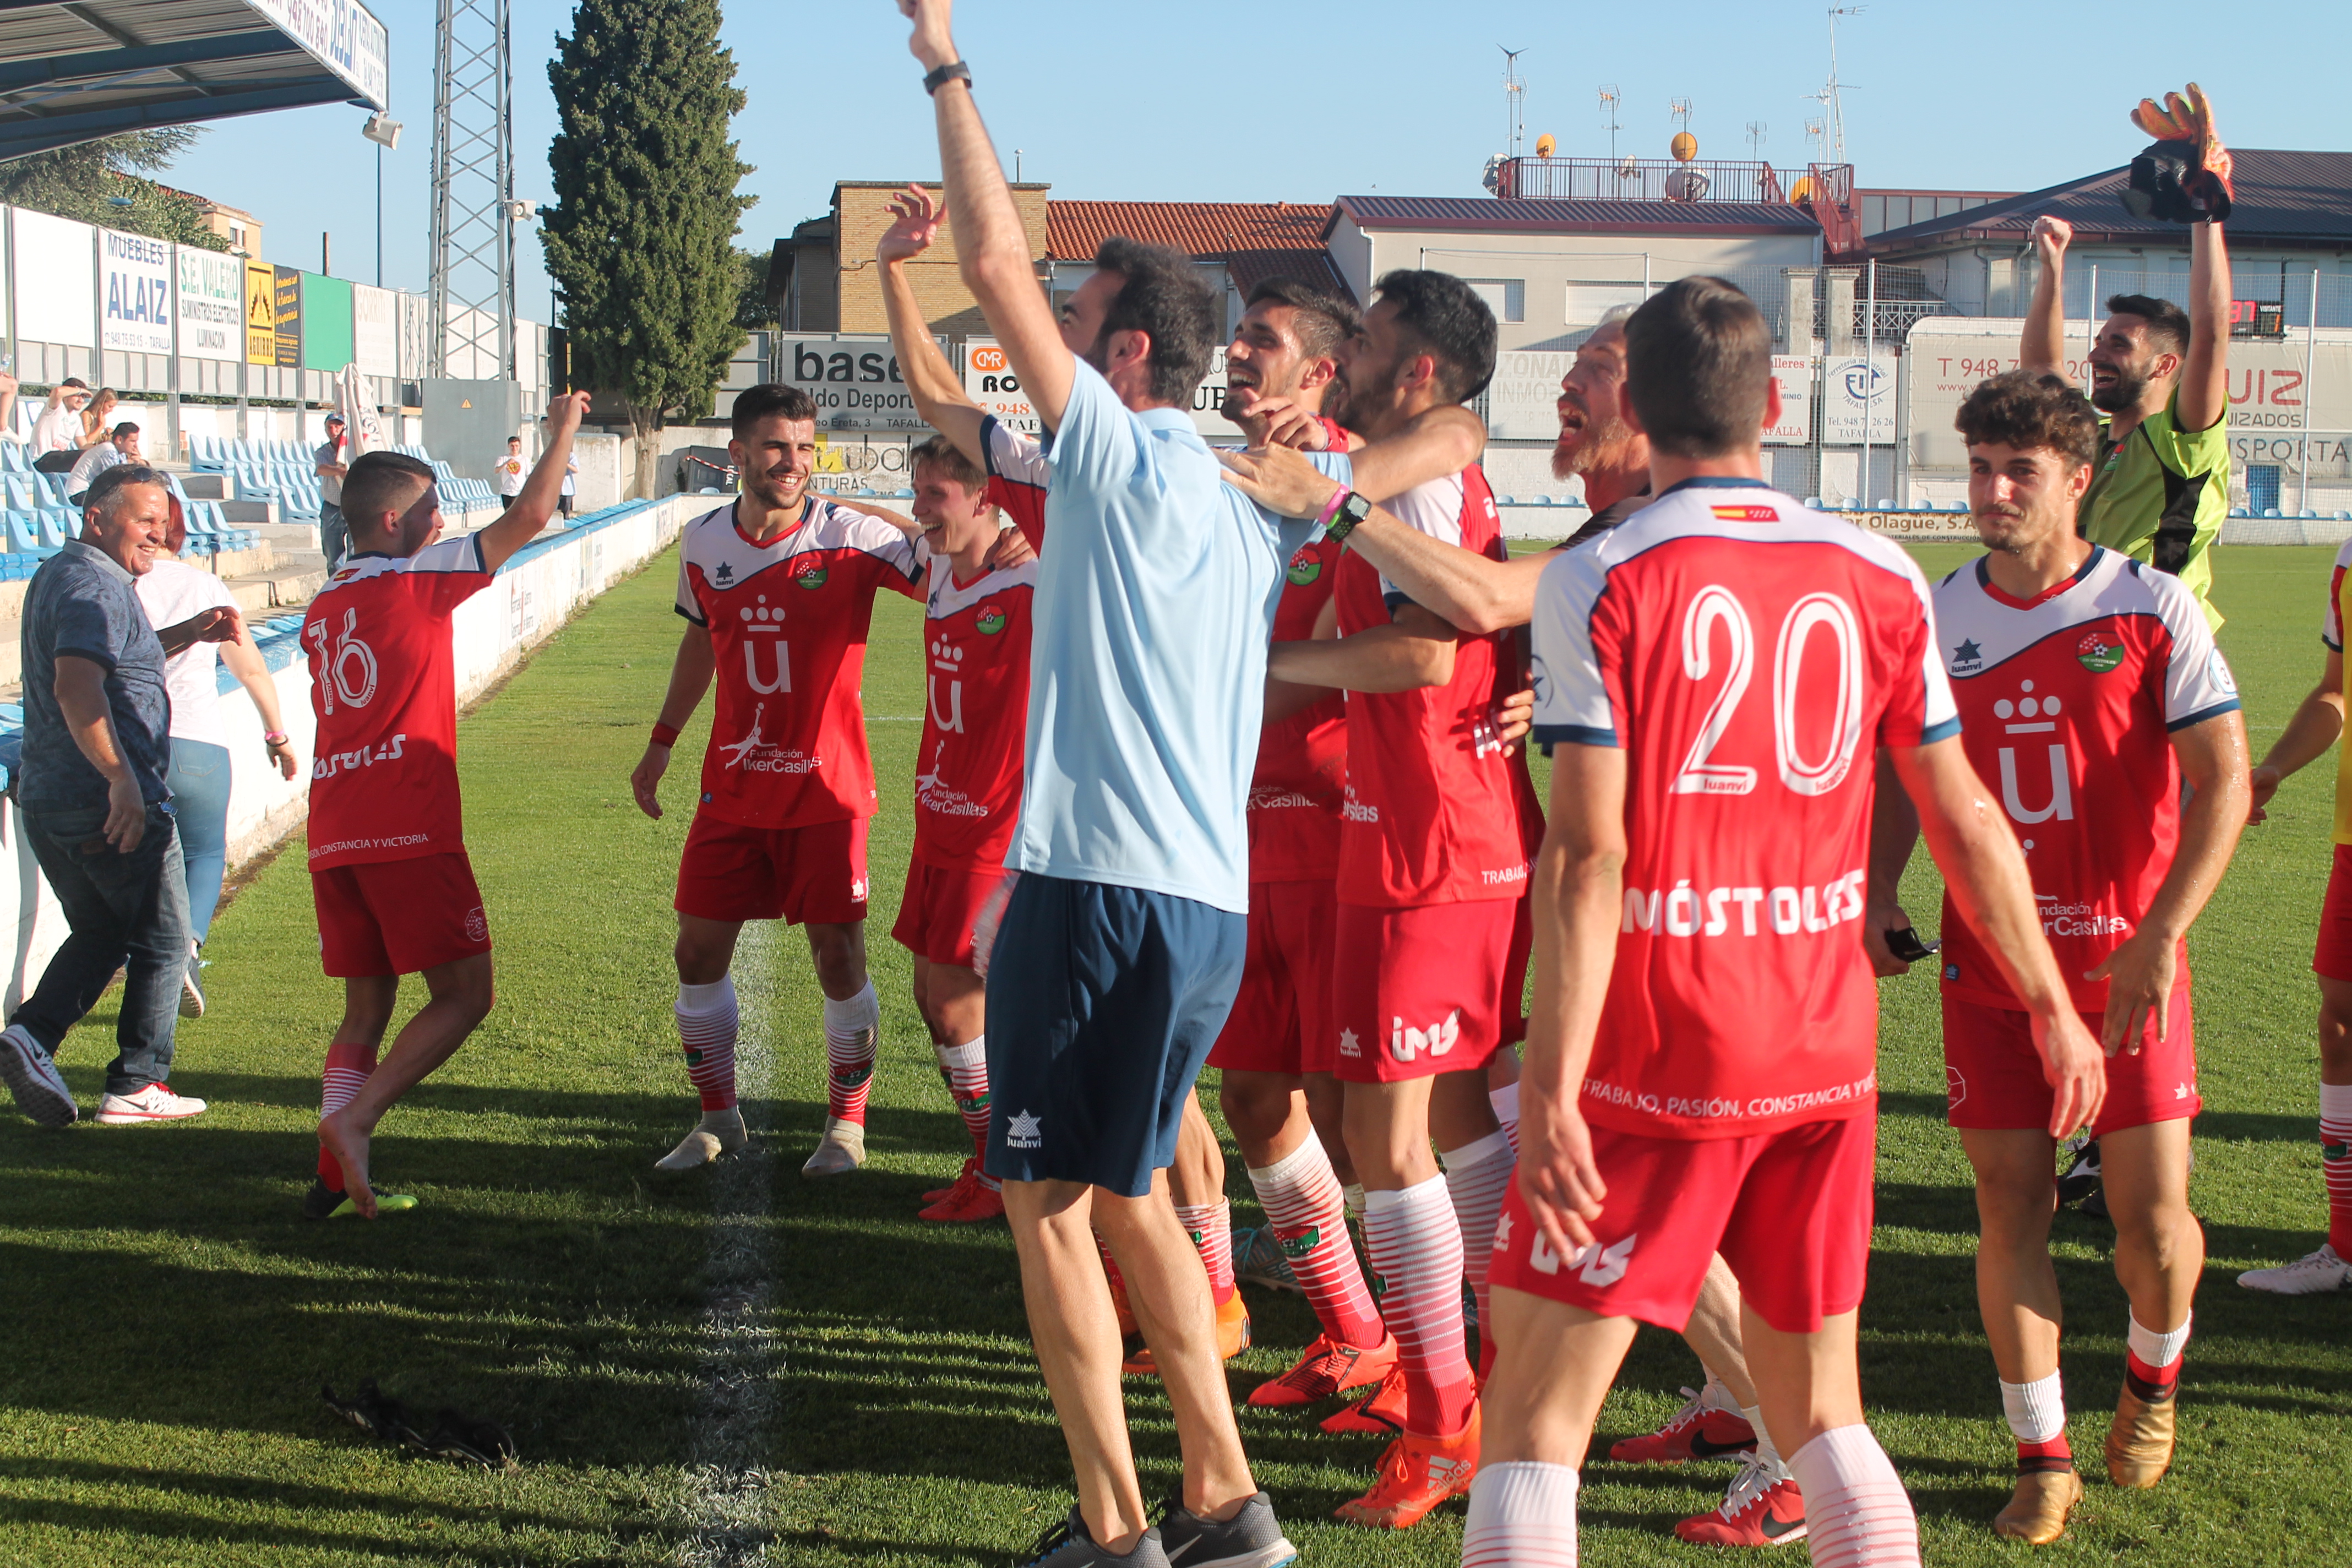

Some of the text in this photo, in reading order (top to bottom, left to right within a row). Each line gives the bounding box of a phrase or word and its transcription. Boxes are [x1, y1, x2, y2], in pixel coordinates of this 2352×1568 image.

[108, 233, 164, 266] MUEBLES
[181, 253, 238, 301] S.E. VALERO
[108, 271, 167, 325] ALAIZ
[2260, 304, 2282, 313] VISITANTE
[182, 299, 239, 326] SUMINISTROS ELECTRICOS
[111, 331, 121, 346] 948
[122, 333, 128, 347] 75
[129, 334, 135, 347] 53
[137, 335, 143, 347] 15
[149, 336, 171, 350] TAFALLA
[197, 328, 226, 350] ILUMINACION
[249, 335, 273, 357] AGUIRRE
[1937, 358, 1953, 377] T
[1961, 358, 1999, 378] 948
[983, 375, 1025, 393] RO
[799, 388, 840, 409] ldo
[996, 402, 1030, 415] 948
[831, 418, 861, 428] Ereta,
[864, 418, 871, 427] 3
[886, 419, 931, 428] TAFALL
[1004, 418, 1042, 431] TAF
[1827, 417, 1842, 426] Tel.
[1844, 417, 1858, 426] 948
[1872, 417, 1882, 426] 26
[1884, 417, 1893, 426] 26
[2228, 438, 2350, 463] SPORTA
[308, 607, 378, 715] 16
[1951, 662, 1982, 673] luanvi
[1669, 585, 1863, 797] 20
[749, 748, 803, 759] Fundación
[1703, 778, 1747, 792] luanvi
[321, 839, 371, 855] CONSTANCIA
[372, 837, 380, 848] Y
[380, 833, 429, 848] VICTORIA
[1621, 868, 1865, 937] MÓSTOLES
[1583, 1076, 1661, 1115] TRABAJO,
[1665, 1096, 1745, 1118] PASIÓN,
[1747, 1085, 1852, 1117] CONSTANCIA
[1007, 1136, 1042, 1148] luanvi
[1429, 1459, 1472, 1499] adidas
